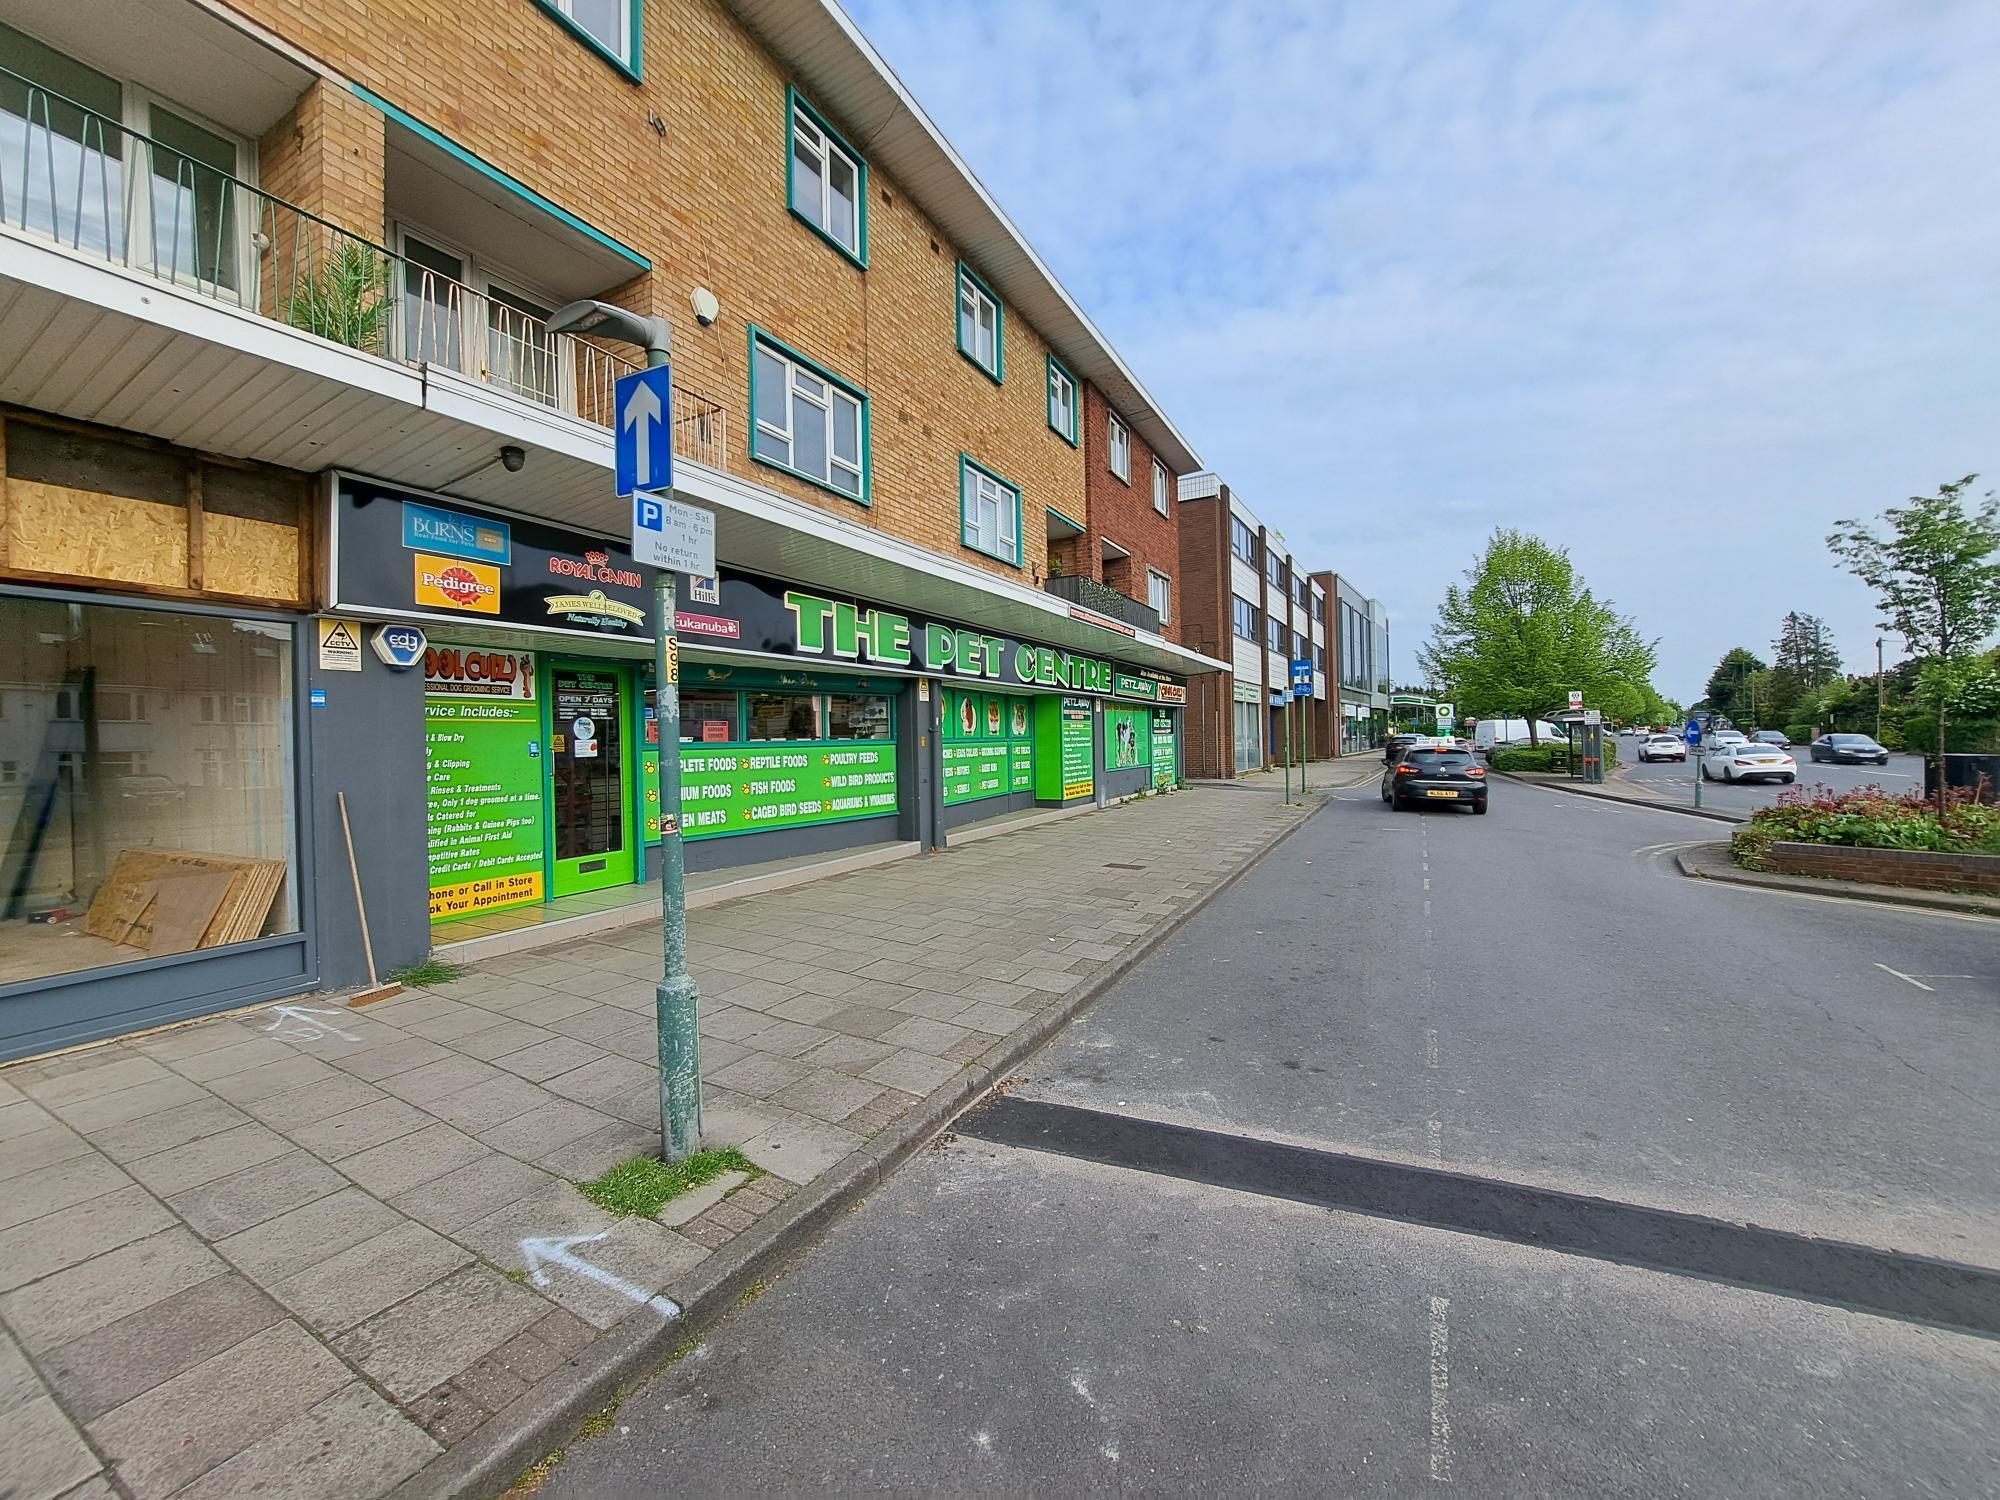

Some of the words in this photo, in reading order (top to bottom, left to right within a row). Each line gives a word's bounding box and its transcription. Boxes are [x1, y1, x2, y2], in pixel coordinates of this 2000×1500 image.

[643, 503, 658, 526] P
[669, 504, 688, 517] Mon
[695, 512, 710, 524] Sat
[413, 517, 474, 542] BURNS
[665, 516, 671, 525] 8
[673, 520, 686, 529] am
[693, 523, 699, 532] 6
[700, 528, 713, 536] pm
[689, 536, 697, 545] hr
[654, 541, 668, 552] No
[671, 547, 699, 560] return
[653, 554, 681, 566] within
[690, 562, 700, 570] hr
[549, 557, 597, 580] ROYAL
[598, 567, 642, 588] CANIN
[422, 573, 494, 595] Pedigree
[694, 590, 717, 603] Hill's
[784, 591, 910, 664] THE
[925, 622, 1004, 677] PET
[1014, 644, 1112, 691] CENTRE
[425, 647, 464, 680] OOL
[425, 682, 448, 691] ESSIONAL
[450, 684, 462, 692] DOG
[463, 685, 490, 693] GROOMING
[491, 686, 511, 694] SERVICE
[558, 695, 582, 703] OPEN
[425, 705, 455, 716] rvice
[454, 734, 464, 742] Dry
[443, 760, 470, 769] Clipping
[708, 758, 737, 771] FOODS
[750, 756, 781, 769] REPTILE
[783, 754, 808, 767] FOODS
[830, 753, 858, 765] POULTRY
[859, 752, 879, 763] FEEDS
[751, 781, 769, 795] FISH
[771, 779, 796, 793] FOODS
[831, 775, 847, 787] WILD
[849, 774, 863, 786] BIRD
[865, 772, 895, 784] PRODUCTS
[431, 786, 454, 794] Rinses
[464, 784, 501, 793] Treatments
[702, 784, 732, 798] FOODS
[443, 799, 458, 808] Only
[466, 797, 478, 806] dog
[480, 795, 508, 806] groomed
[437, 811, 463, 820] Catered
[466, 810, 476, 818] for
[752, 804, 778, 819] CAGED
[780, 802, 797, 816] BIRD
[799, 800, 822, 814] SEEDS
[698, 810, 727, 825] MEATS
[444, 824, 472, 834] (Rabbits
[483, 820, 504, 829] Guinea
[506, 819, 520, 828] Pigs
[459, 836, 482, 845] Animal
[485, 834, 499, 842] First
[502, 831, 512, 840] Aid
[460, 848, 480, 857] Rates
[430, 865, 450, 874] Credit
[452, 862, 471, 871] Cards
[479, 858, 495, 867] Debit
[498, 855, 514, 864] Cards
[516, 852, 543, 862] Accepted
[429, 889, 454, 900] hone
[459, 887, 469, 895] or
[473, 882, 492, 893] Call
[496, 880, 505, 889] in
[509, 877, 533, 887] Store
[430, 903, 442, 914] ok
[446, 900, 469, 911] Your
[473, 888, 533, 907] Appointment
